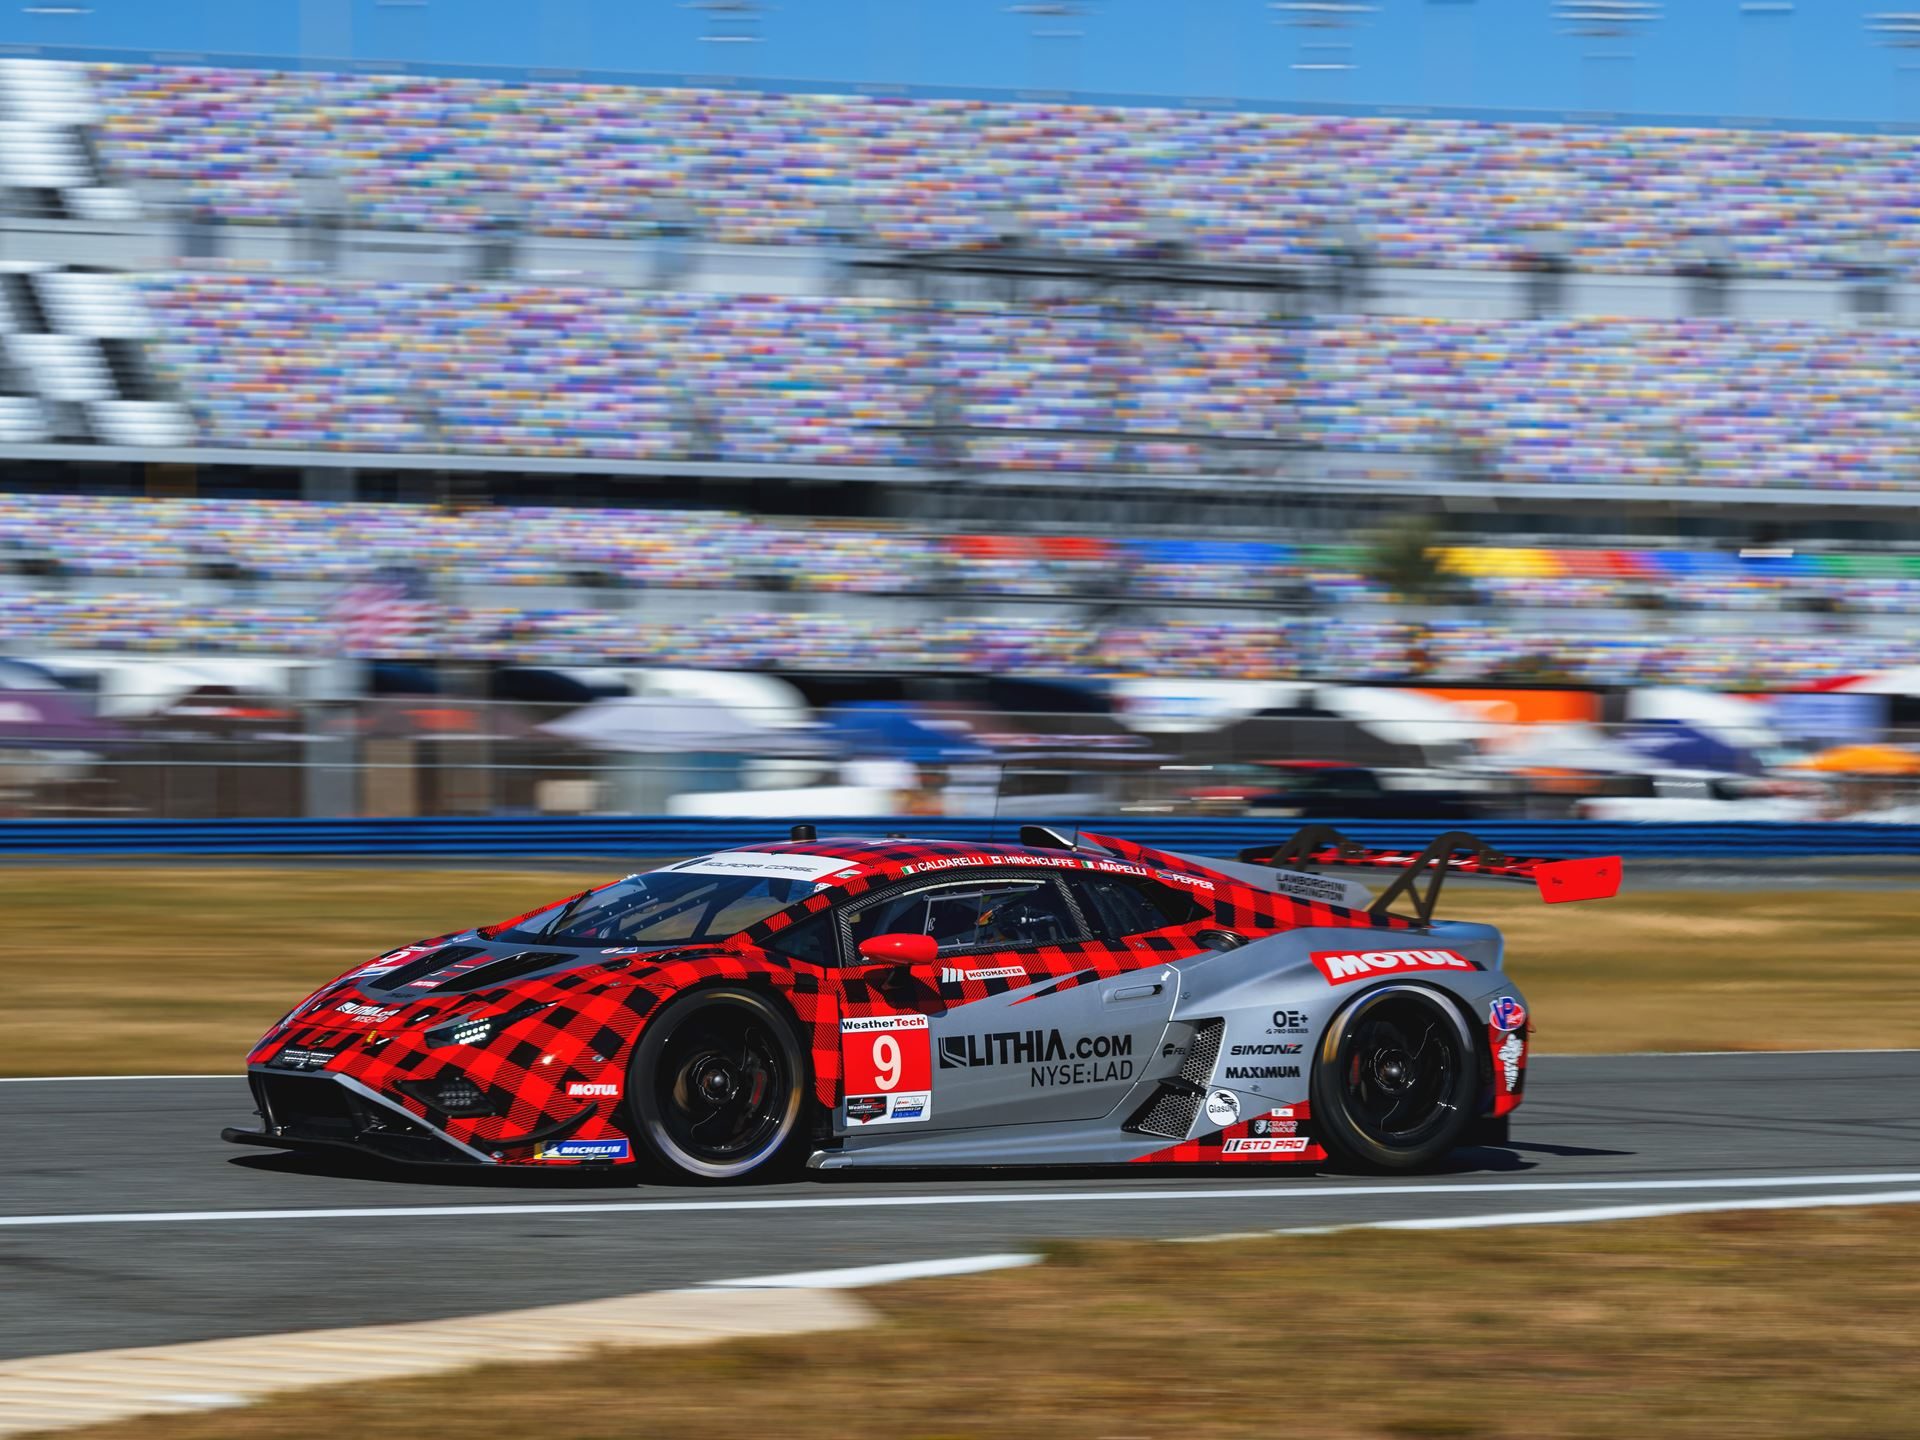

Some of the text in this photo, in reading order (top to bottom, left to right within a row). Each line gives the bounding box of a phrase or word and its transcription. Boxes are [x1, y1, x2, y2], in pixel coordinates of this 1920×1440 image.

[917, 856, 1216, 891] CALDARELLI HINCHCLIFFE MAPELLI PEPPER
[1275, 872, 1347, 893] LAMBORGHINI
[1277, 882, 1345, 902] WASHINGTON
[968, 966, 1024, 979] MOTOMASTER
[1324, 950, 1468, 979] MOTUL
[842, 1017, 926, 1030] WeatherTech
[1273, 1010, 1308, 1028] OE+
[967, 1029, 1132, 1067] LITHIA.COM
[872, 1034, 902, 1091] 9
[1225, 1065, 1301, 1079] MAXIMUM
[1030, 1059, 1133, 1087] NYSE:LAD
[568, 1084, 619, 1096] MOTUL
[561, 1145, 621, 1154] MICHELIN
[1240, 1140, 1304, 1151] GTD PRO
